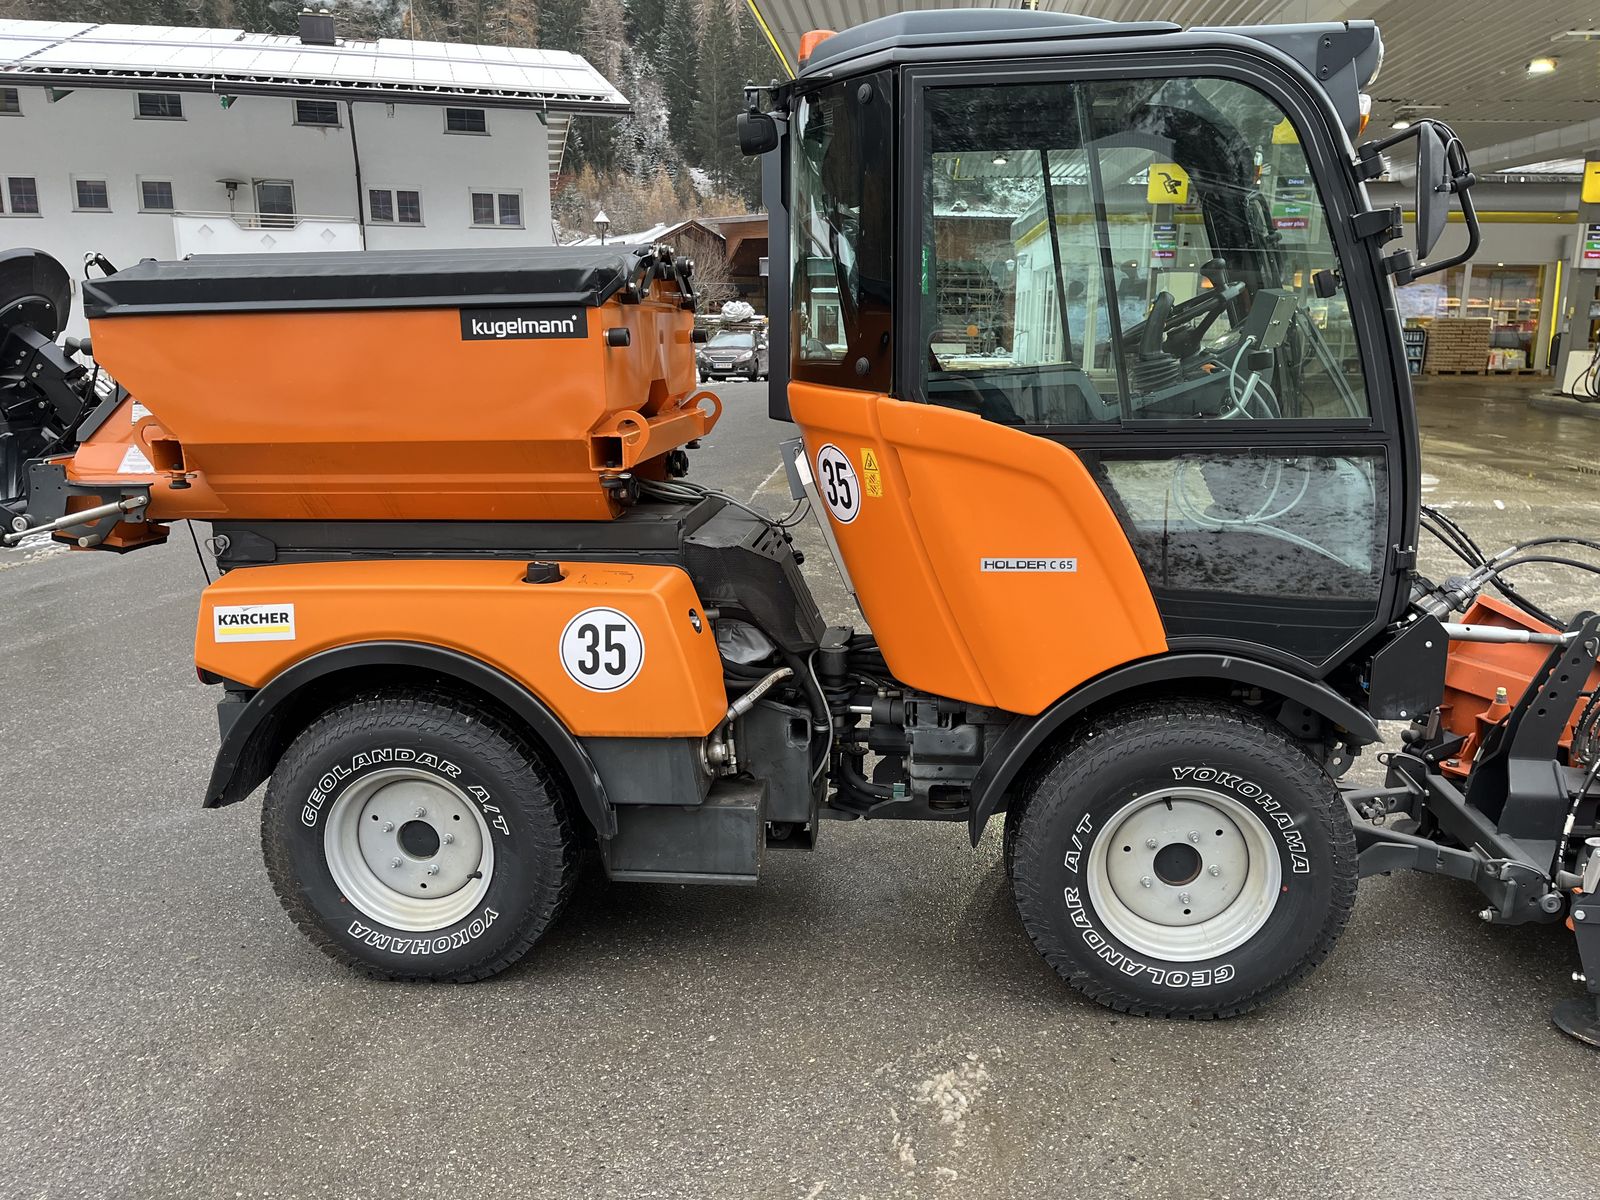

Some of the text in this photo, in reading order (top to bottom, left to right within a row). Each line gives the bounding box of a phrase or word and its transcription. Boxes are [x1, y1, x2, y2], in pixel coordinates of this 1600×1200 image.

[471, 317, 574, 338] kugelmann
[822, 458, 853, 510] 35
[984, 560, 1073, 570] HOLDER C 65
[218, 612, 290, 626] KÄRCHER
[577, 623, 627, 676] 35
[301, 748, 511, 836] GEOLANDAR A/T
[1171, 766, 1311, 874] YOKOHAMA
[1063, 812, 1236, 988] GEOLANDAR A/T
[347, 907, 500, 955] YOKOHAMA
